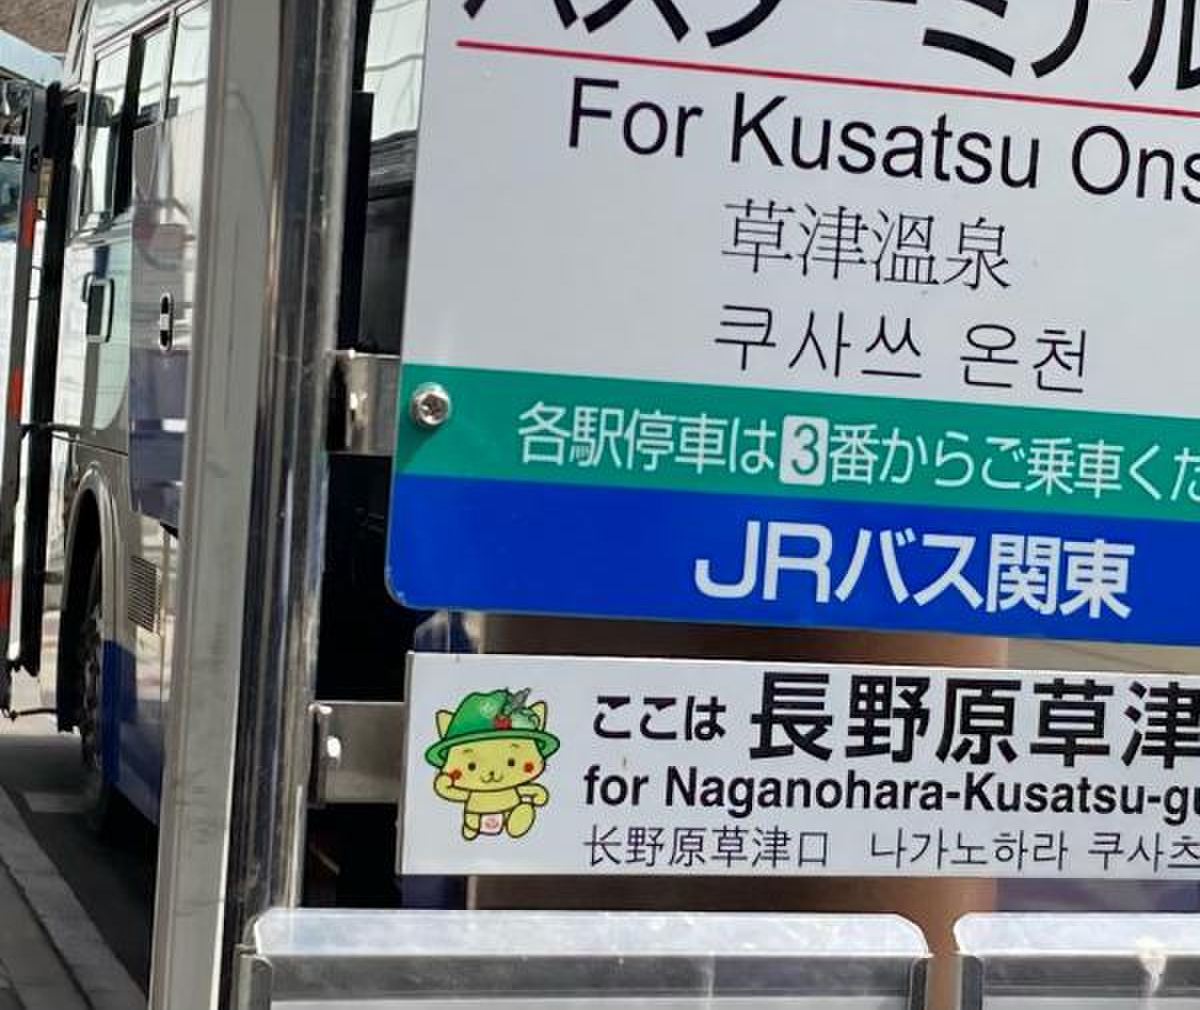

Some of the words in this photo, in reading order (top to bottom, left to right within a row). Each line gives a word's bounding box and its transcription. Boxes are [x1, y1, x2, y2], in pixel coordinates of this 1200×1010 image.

[567, 76, 702, 159] For
[729, 92, 1040, 188] Kusatsu
[713, 303, 922, 379] 쿠사쓰
[960, 322, 1087, 393] 온천
[694, 519, 1136, 620] JRバス関東
[583, 765, 649, 807] for
[583, 823, 830, 868] 长野原草津口
[870, 826, 1069, 872] 나가노하라
